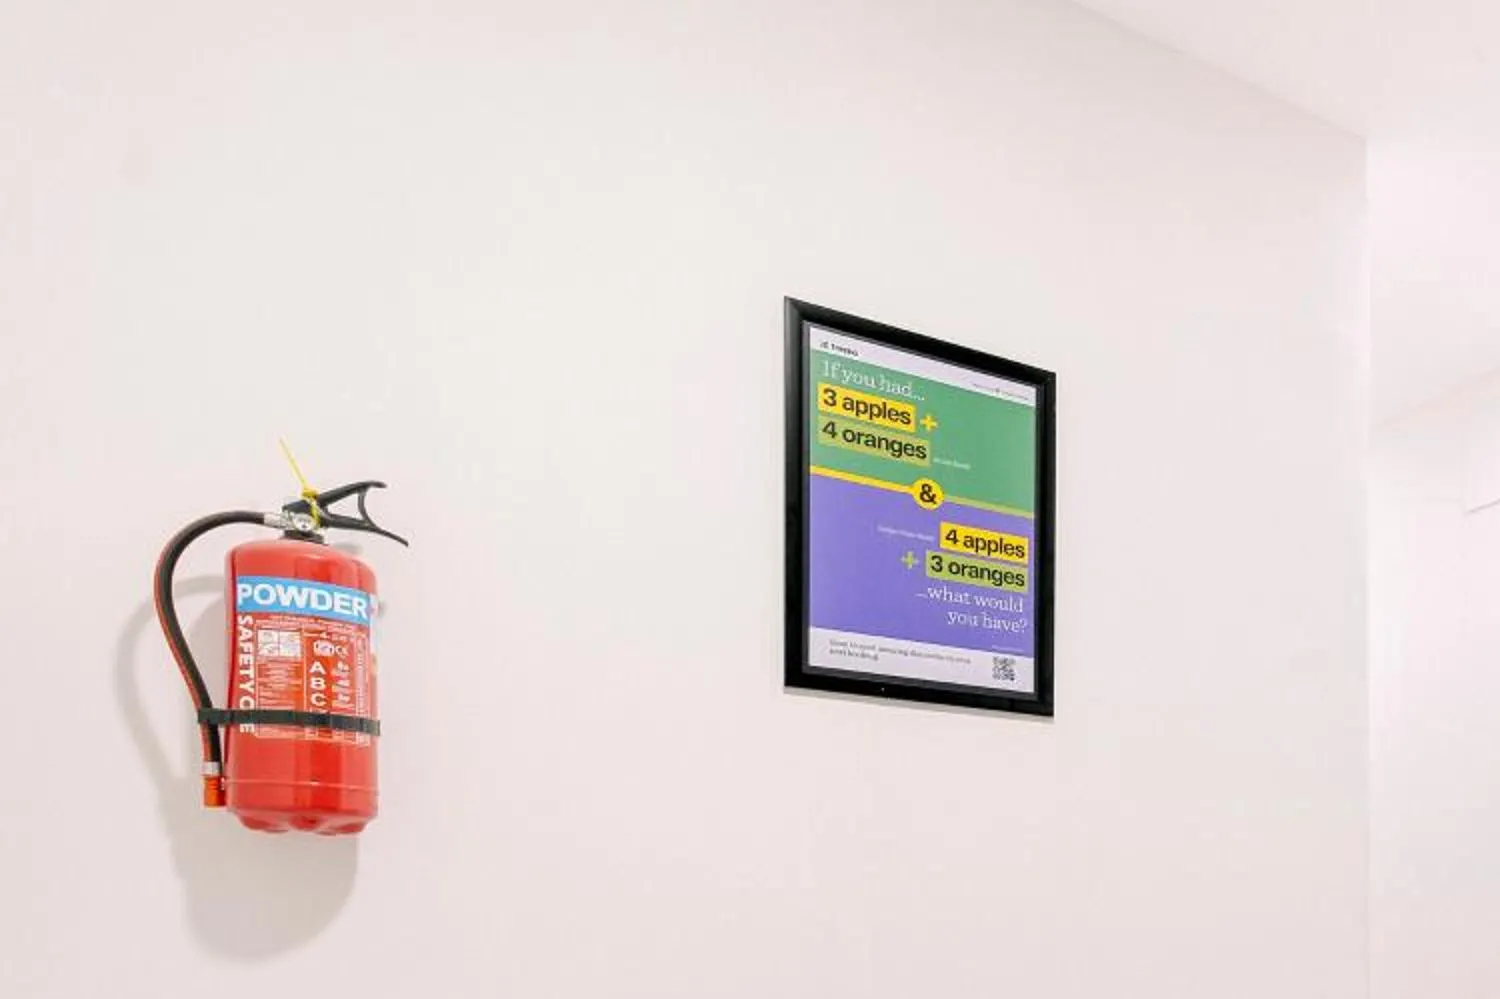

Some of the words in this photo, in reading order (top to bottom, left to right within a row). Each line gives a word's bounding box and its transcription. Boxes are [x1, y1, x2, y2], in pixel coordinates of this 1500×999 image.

[841, 368, 876, 389] you
[823, 387, 837, 407] 3
[843, 396, 912, 426] apples
[822, 421, 837, 439] 4
[843, 428, 927, 460] oranges
[919, 483, 937, 505] &
[945, 529, 959, 545] 4
[963, 534, 1025, 559] apples
[931, 554, 944, 573] 3
[948, 559, 1026, 587] oranges
[237, 583, 368, 620] POWDER
[974, 591, 1024, 613] would
[947, 608, 979, 627] you
[983, 611, 1027, 634] have?
[309, 661, 326, 674] A
[310, 677, 326, 690] B
[310, 693, 327, 707] C
